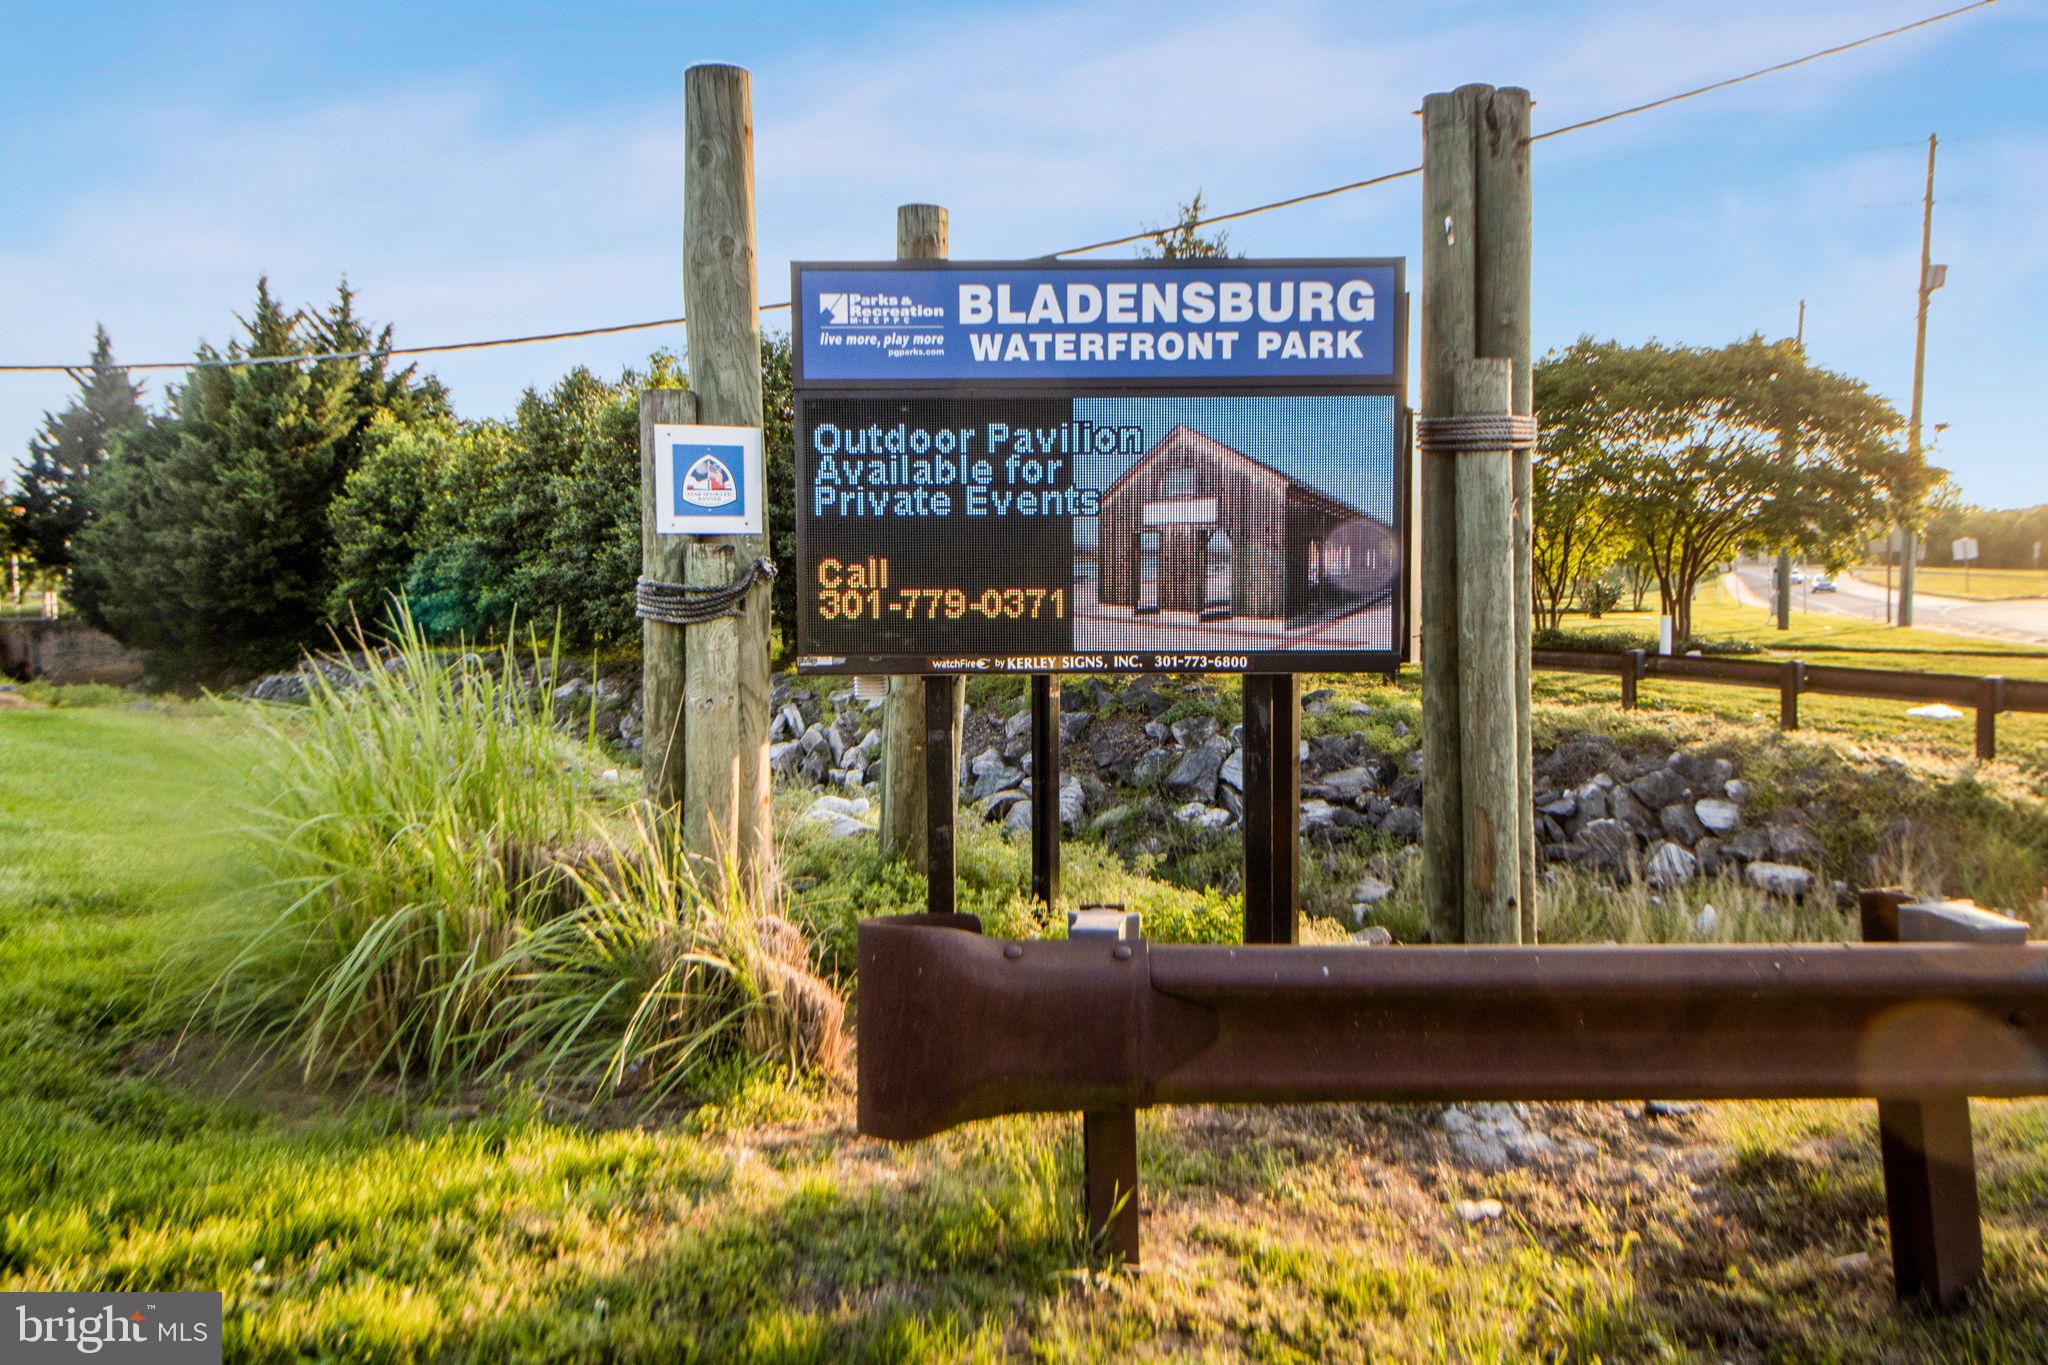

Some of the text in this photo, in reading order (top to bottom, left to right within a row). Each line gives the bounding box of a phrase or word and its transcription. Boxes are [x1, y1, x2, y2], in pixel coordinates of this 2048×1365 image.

[850, 293, 912, 306] Parks &
[850, 305, 944, 317] Recreation
[959, 281, 1375, 325] BLADENSBURG
[820, 331, 944, 349] live more, play more
[888, 348, 944, 358] pgparks.com
[969, 330, 1364, 361] WATERFRONT PARK
[813, 421, 1144, 456] Outdoor Pavilion
[814, 454, 1062, 486] Available for
[814, 485, 1100, 517] Private Events
[818, 555, 889, 588] Call
[818, 588, 1065, 620] 301-779-0371
[995, 658, 1005, 669] by
[1007, 656, 1056, 669] KERLEY
[1062, 656, 1108, 669] SIGNS,
[1114, 655, 1143, 668] INC.
[1154, 655, 1248, 668] 301-773-6800
